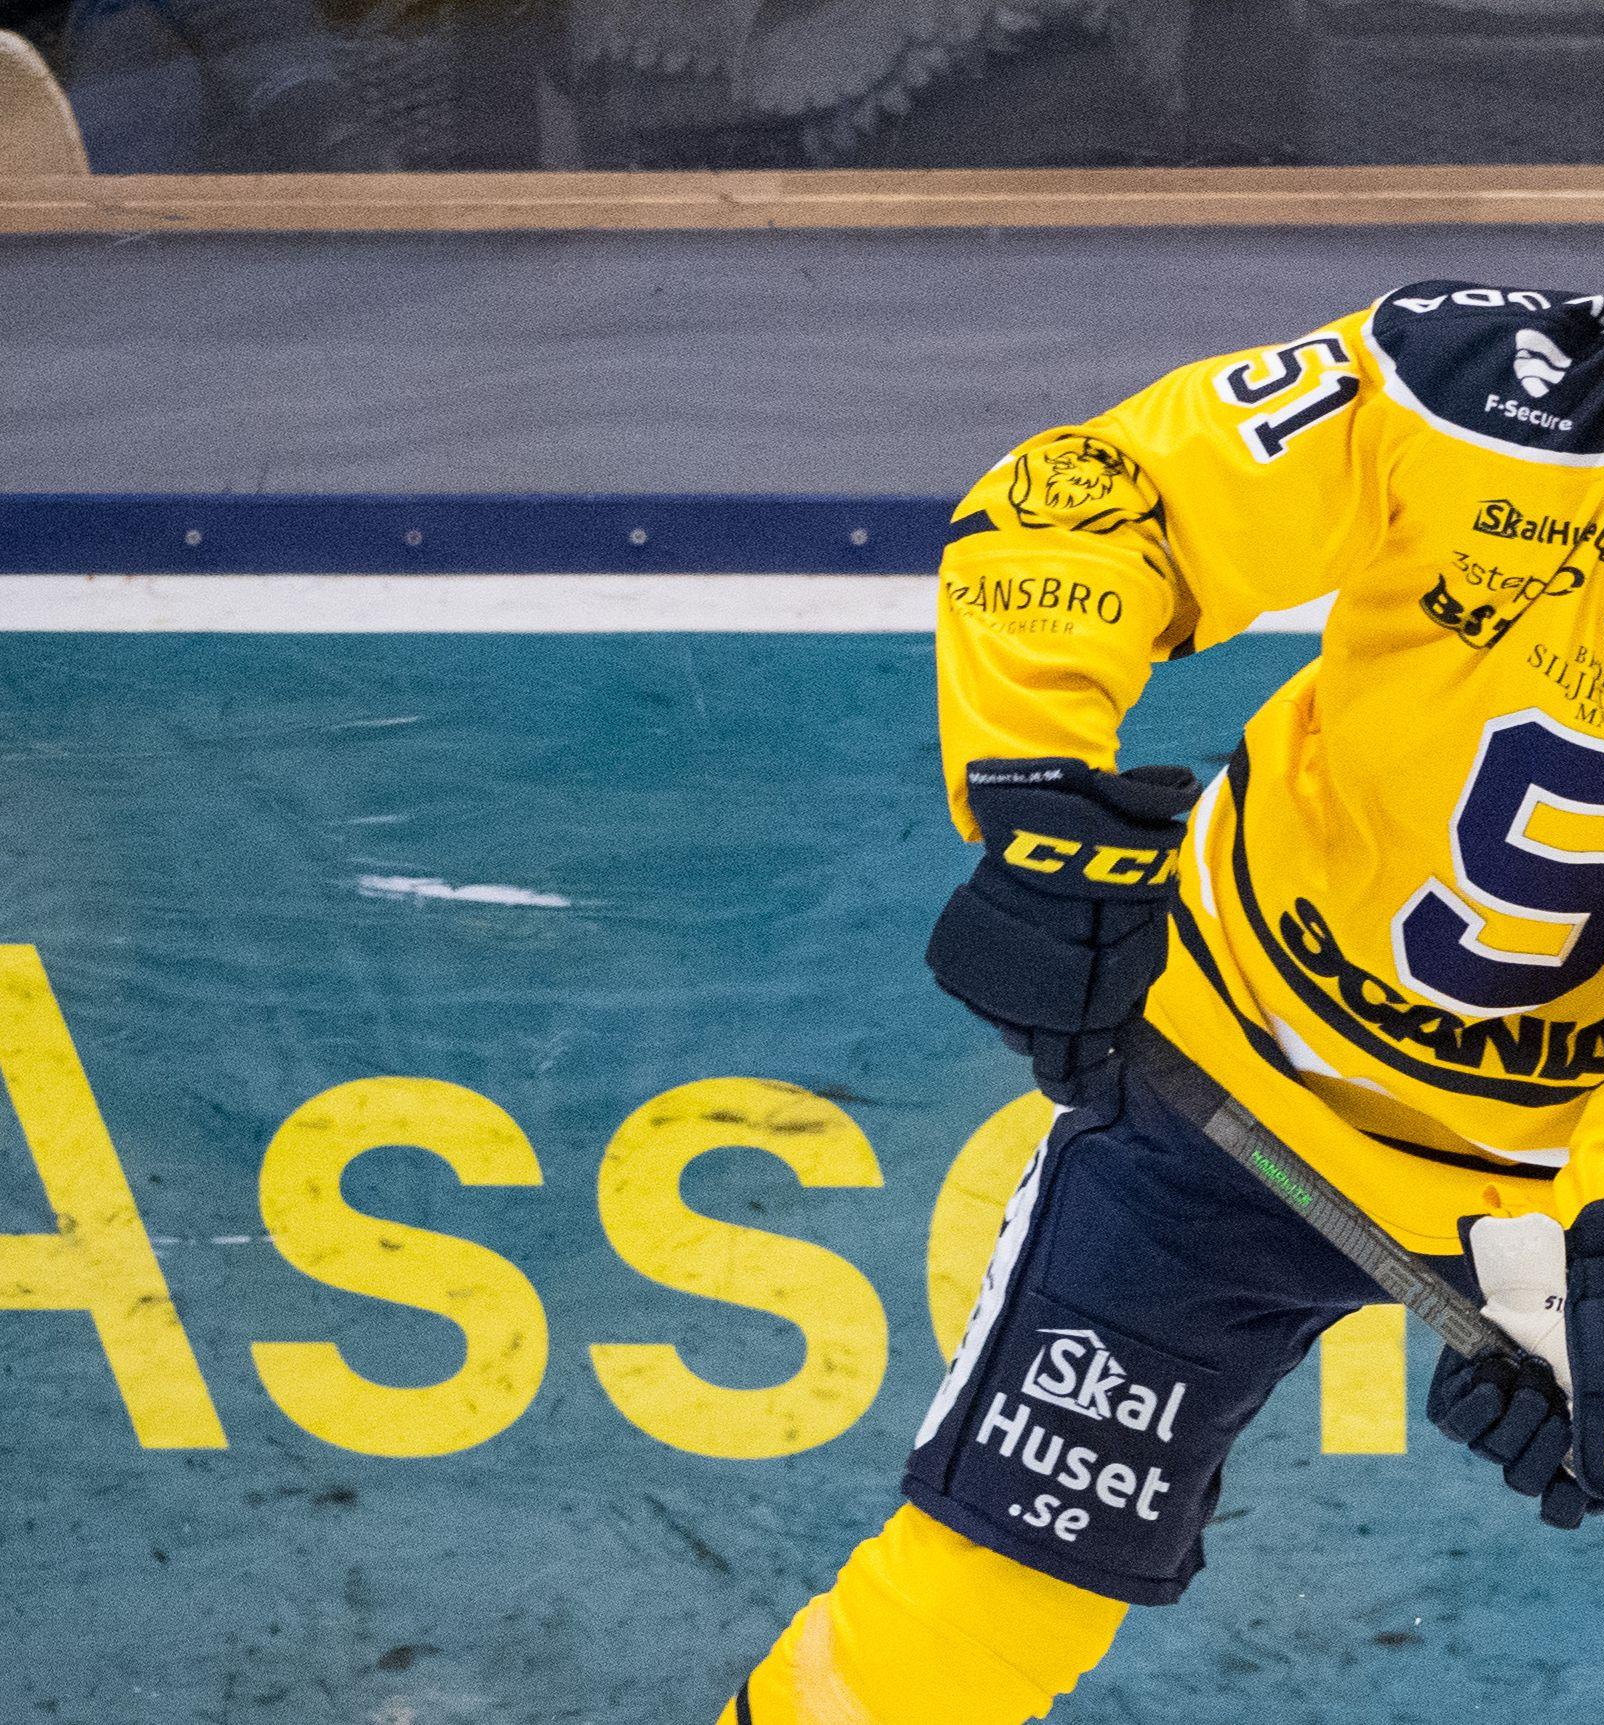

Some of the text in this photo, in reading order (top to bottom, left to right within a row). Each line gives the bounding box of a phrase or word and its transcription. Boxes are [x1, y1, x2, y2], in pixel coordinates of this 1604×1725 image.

[1213, 331, 1361, 464] 51
[1484, 393, 1573, 433] F-Secure
[1544, 1295, 1564, 1312] 51
[1035, 1334, 1186, 1443] Skal
[976, 1391, 1171, 1521] Huset
[1008, 1493, 1092, 1543] .se
